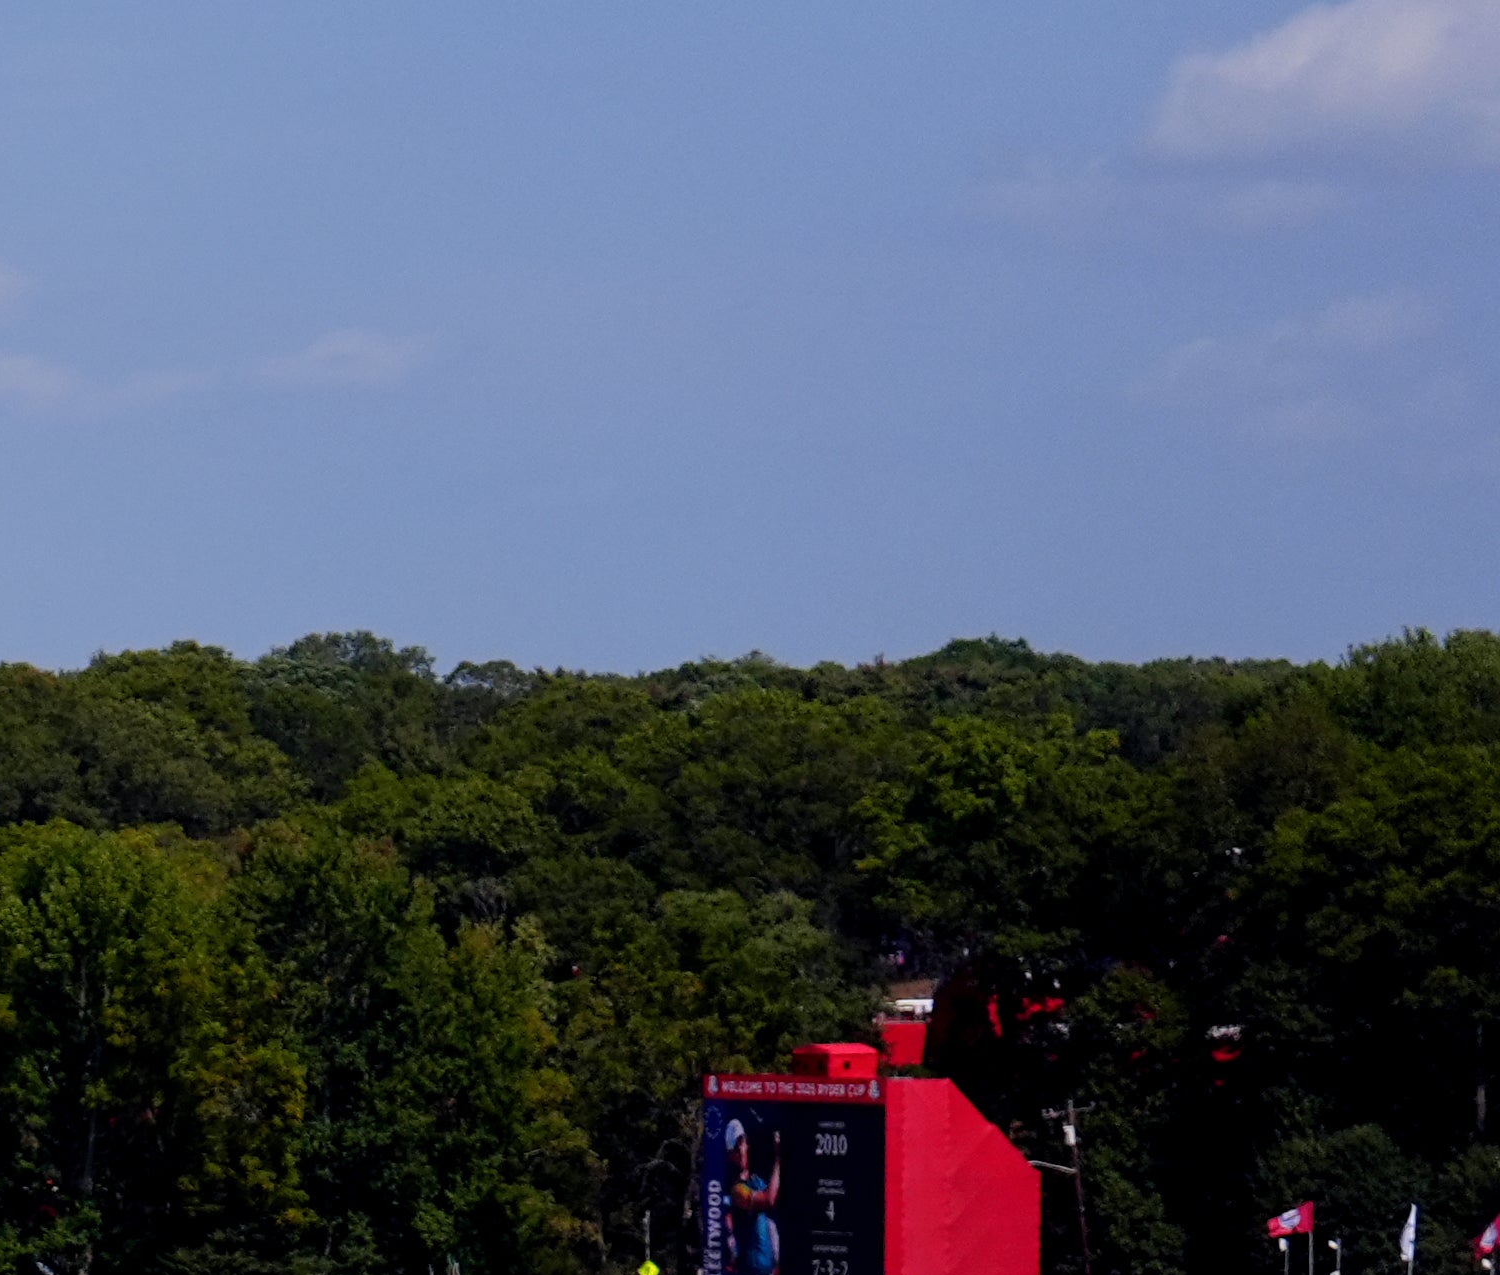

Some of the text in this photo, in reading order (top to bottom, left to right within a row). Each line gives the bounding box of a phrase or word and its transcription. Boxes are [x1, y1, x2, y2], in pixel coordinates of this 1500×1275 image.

[765, 1081, 777, 1093] TO
[815, 1133, 848, 1156] 2010
[825, 1200, 836, 1222] 4
